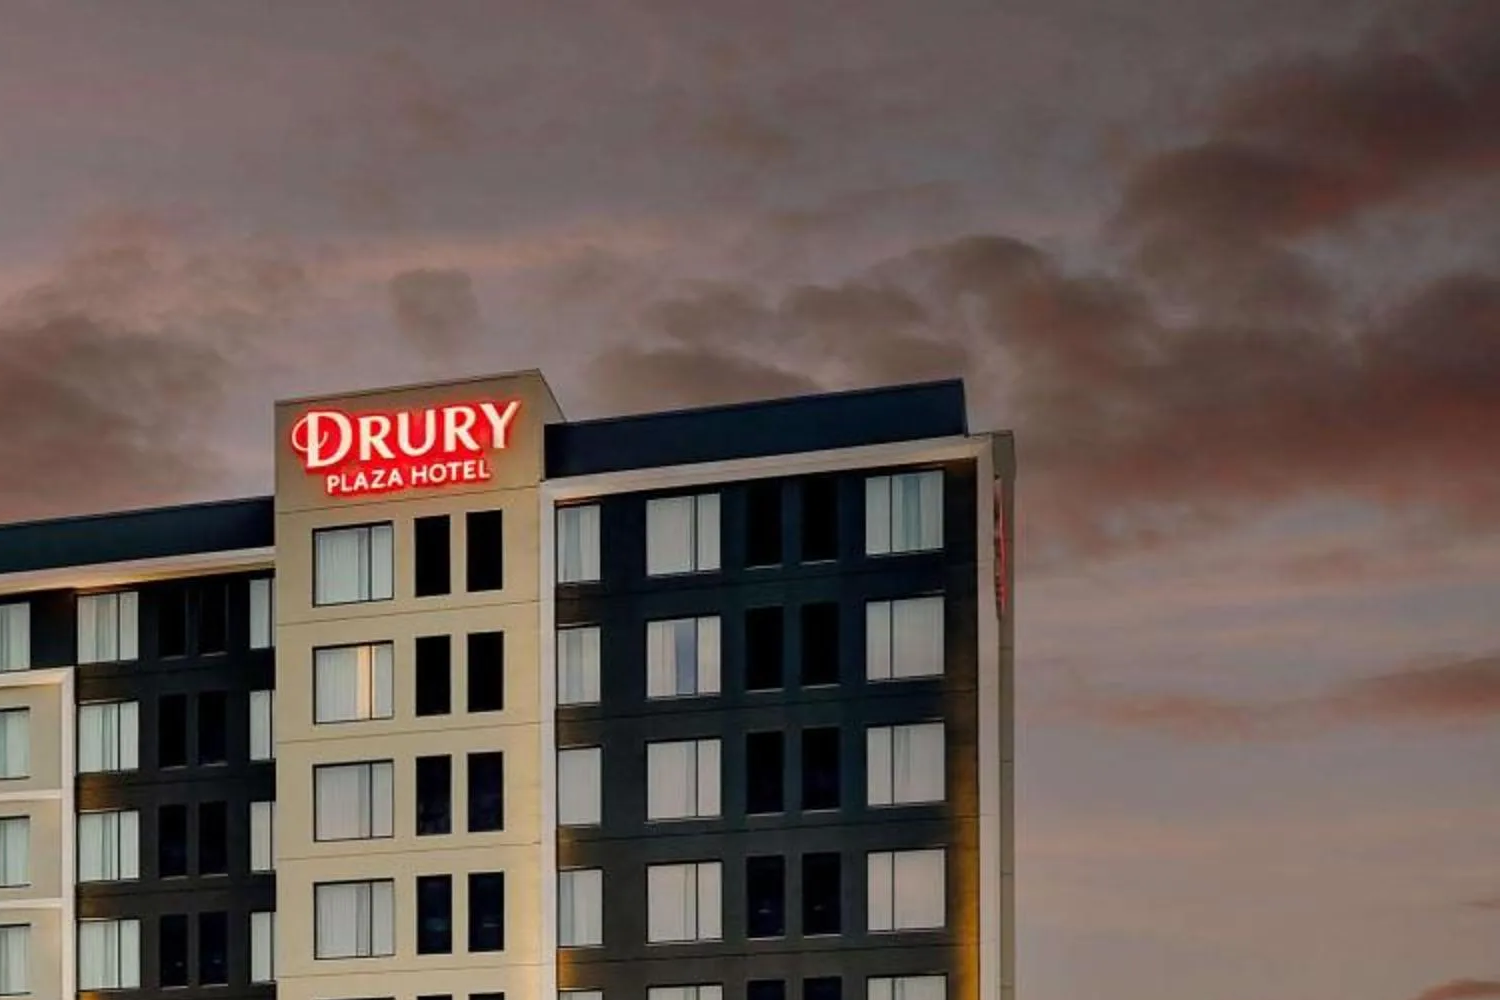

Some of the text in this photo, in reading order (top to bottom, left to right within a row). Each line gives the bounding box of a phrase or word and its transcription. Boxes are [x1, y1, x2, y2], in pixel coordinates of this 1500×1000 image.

[291, 400, 520, 469] DRURY
[326, 458, 491, 494] PLAZA HOTEL
